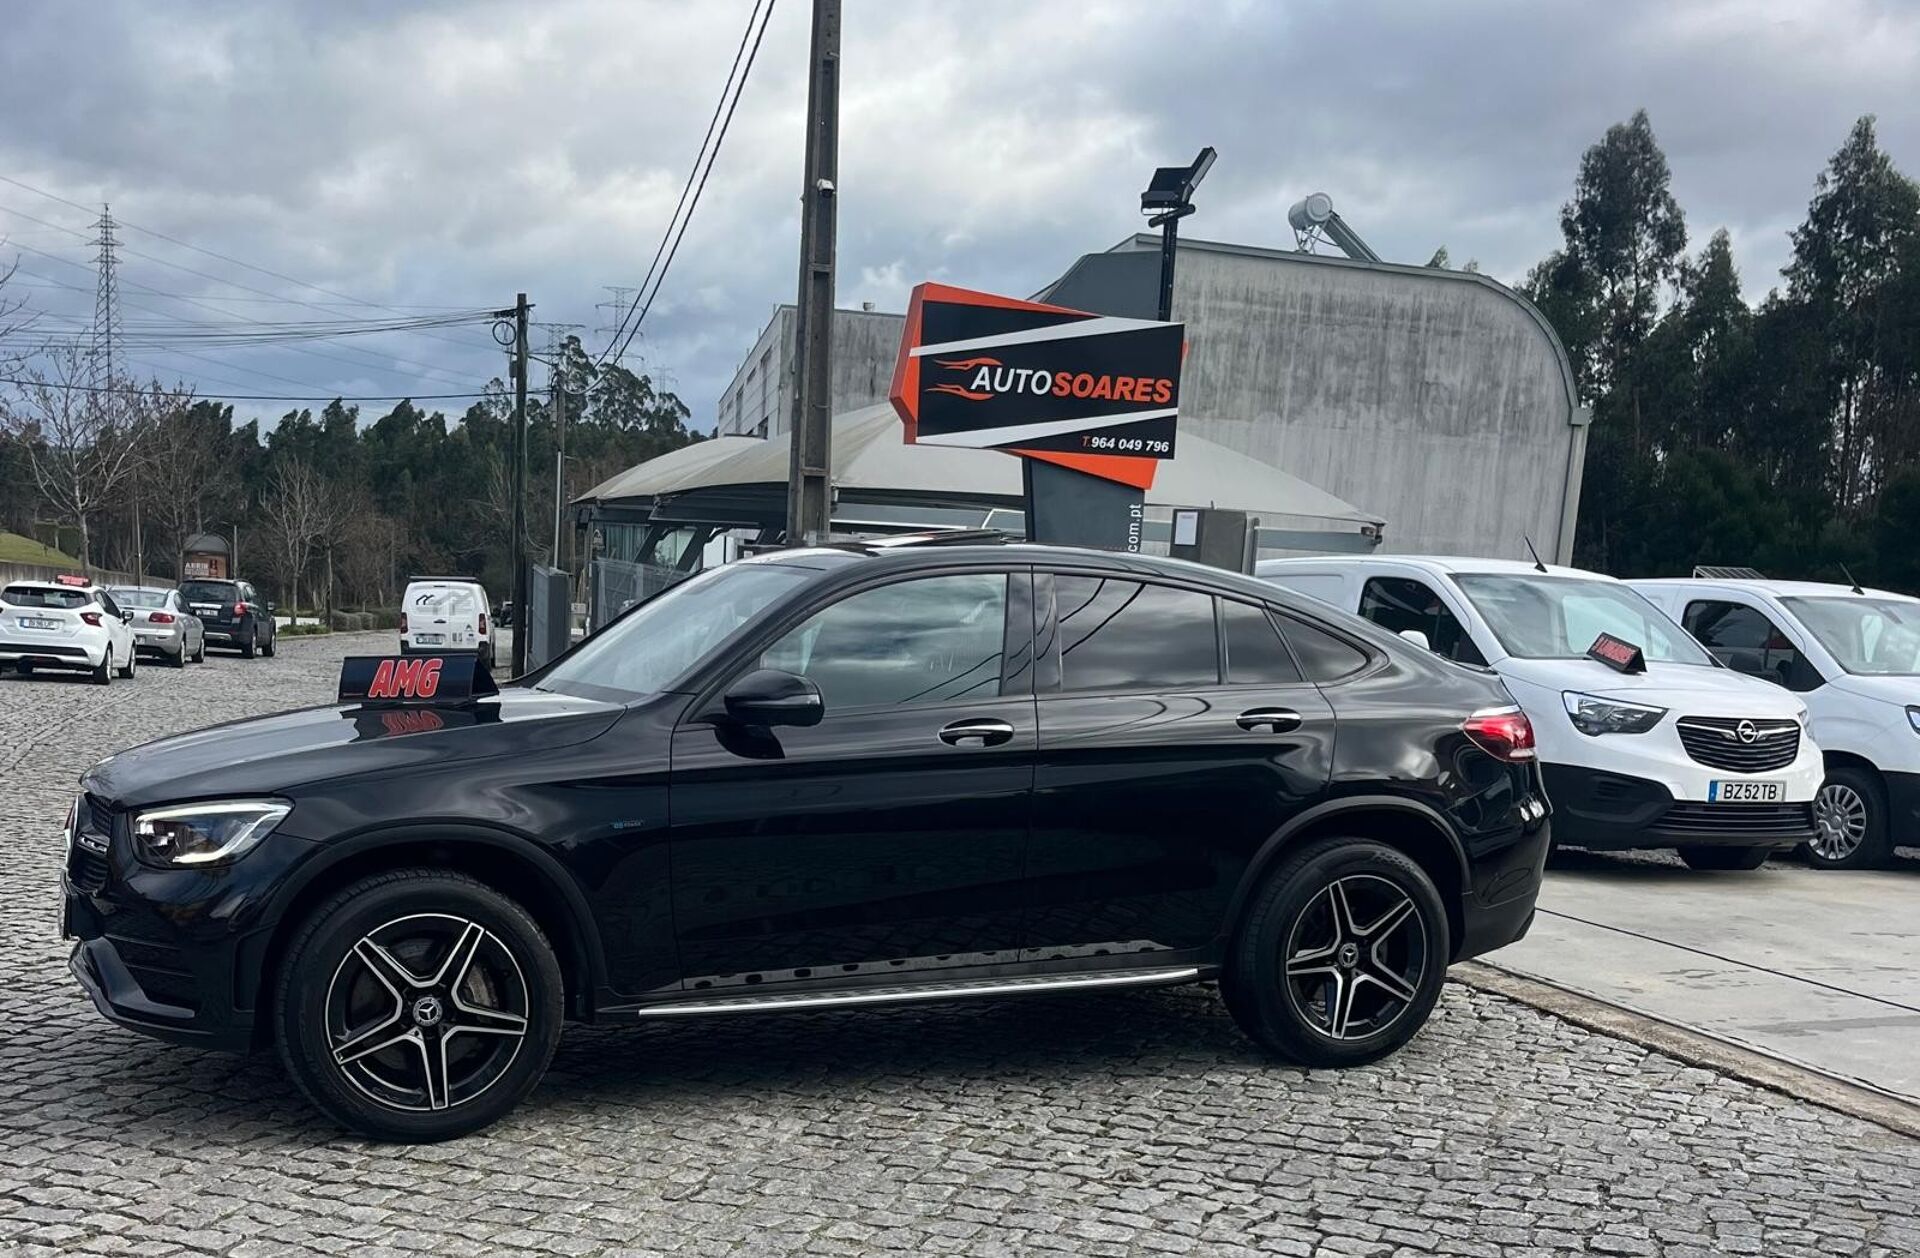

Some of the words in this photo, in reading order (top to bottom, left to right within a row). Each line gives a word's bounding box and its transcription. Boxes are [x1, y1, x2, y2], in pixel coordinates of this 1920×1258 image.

[1118, 438, 1143, 451] 049
[1146, 440, 1170, 453] 796
[367, 658, 442, 698] AMG
